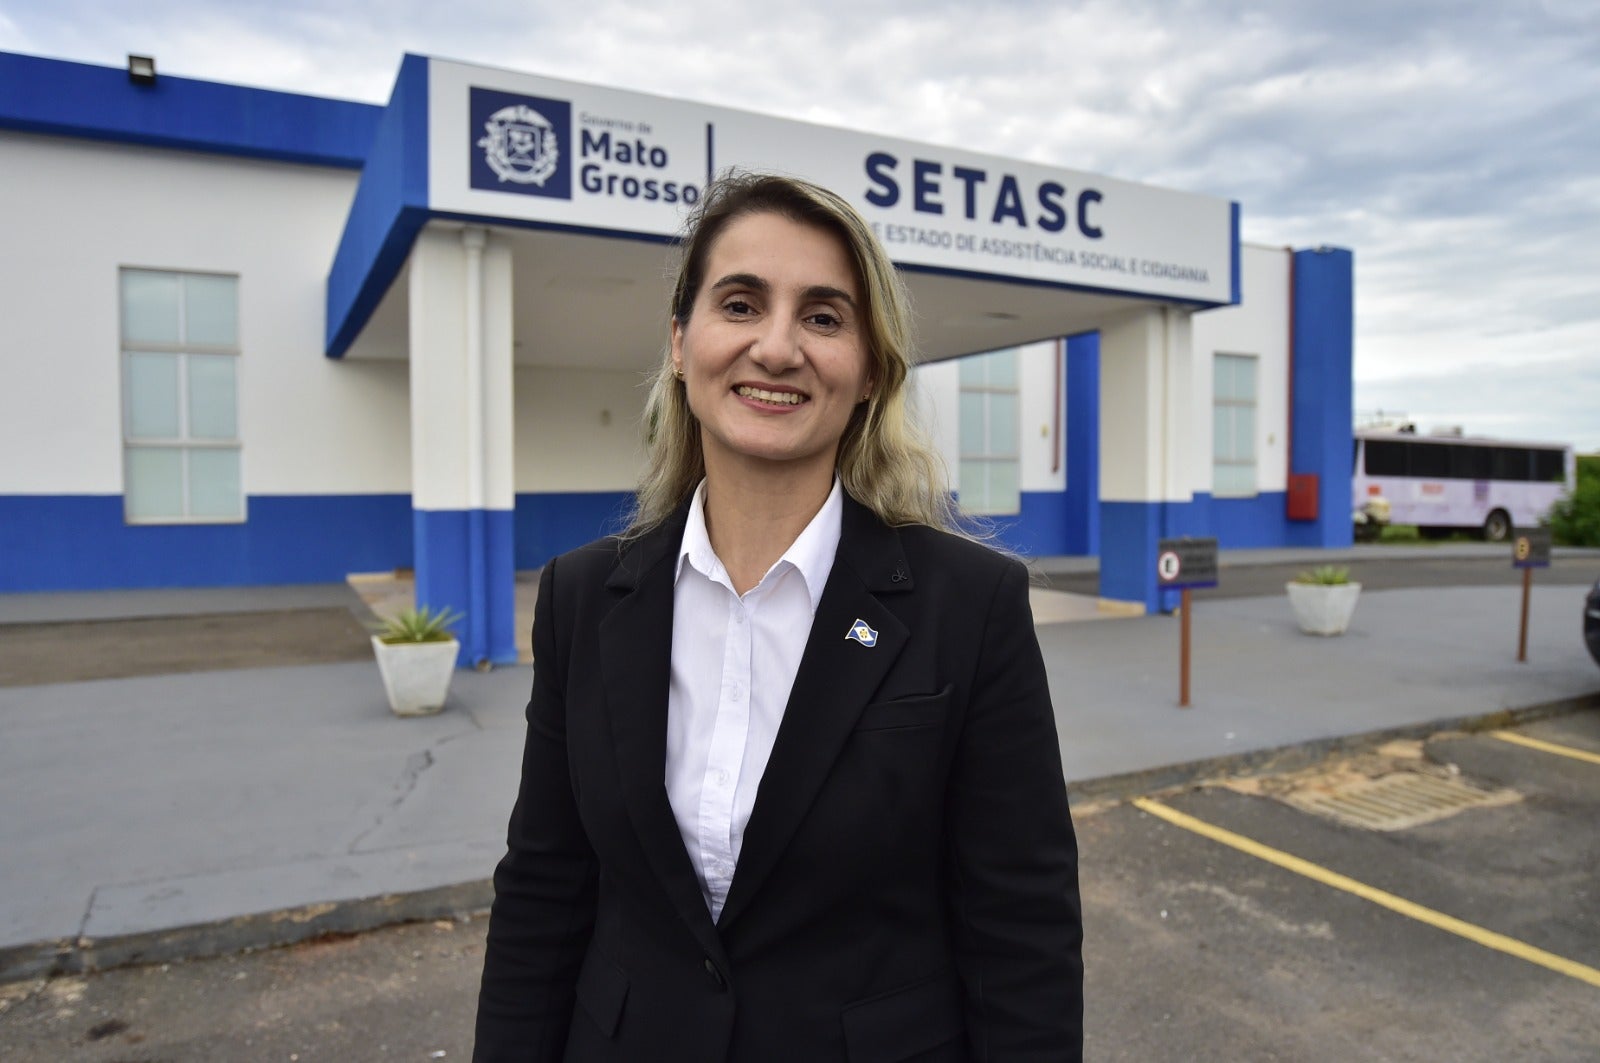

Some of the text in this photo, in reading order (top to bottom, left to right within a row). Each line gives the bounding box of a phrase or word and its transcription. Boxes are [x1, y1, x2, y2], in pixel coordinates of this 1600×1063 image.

[580, 112, 652, 133] Governo de
[580, 129, 667, 168] Mato
[580, 164, 699, 204] Grosso
[865, 152, 1104, 239] SETASC
[886, 224, 952, 249] ESTADO
[955, 233, 977, 253] DE
[978, 236, 1077, 265] ASSISTÊNCIA
[1079, 250, 1126, 274] SOCIAL
[1128, 258, 1137, 275] E
[1141, 260, 1210, 283] CIDADANIA
